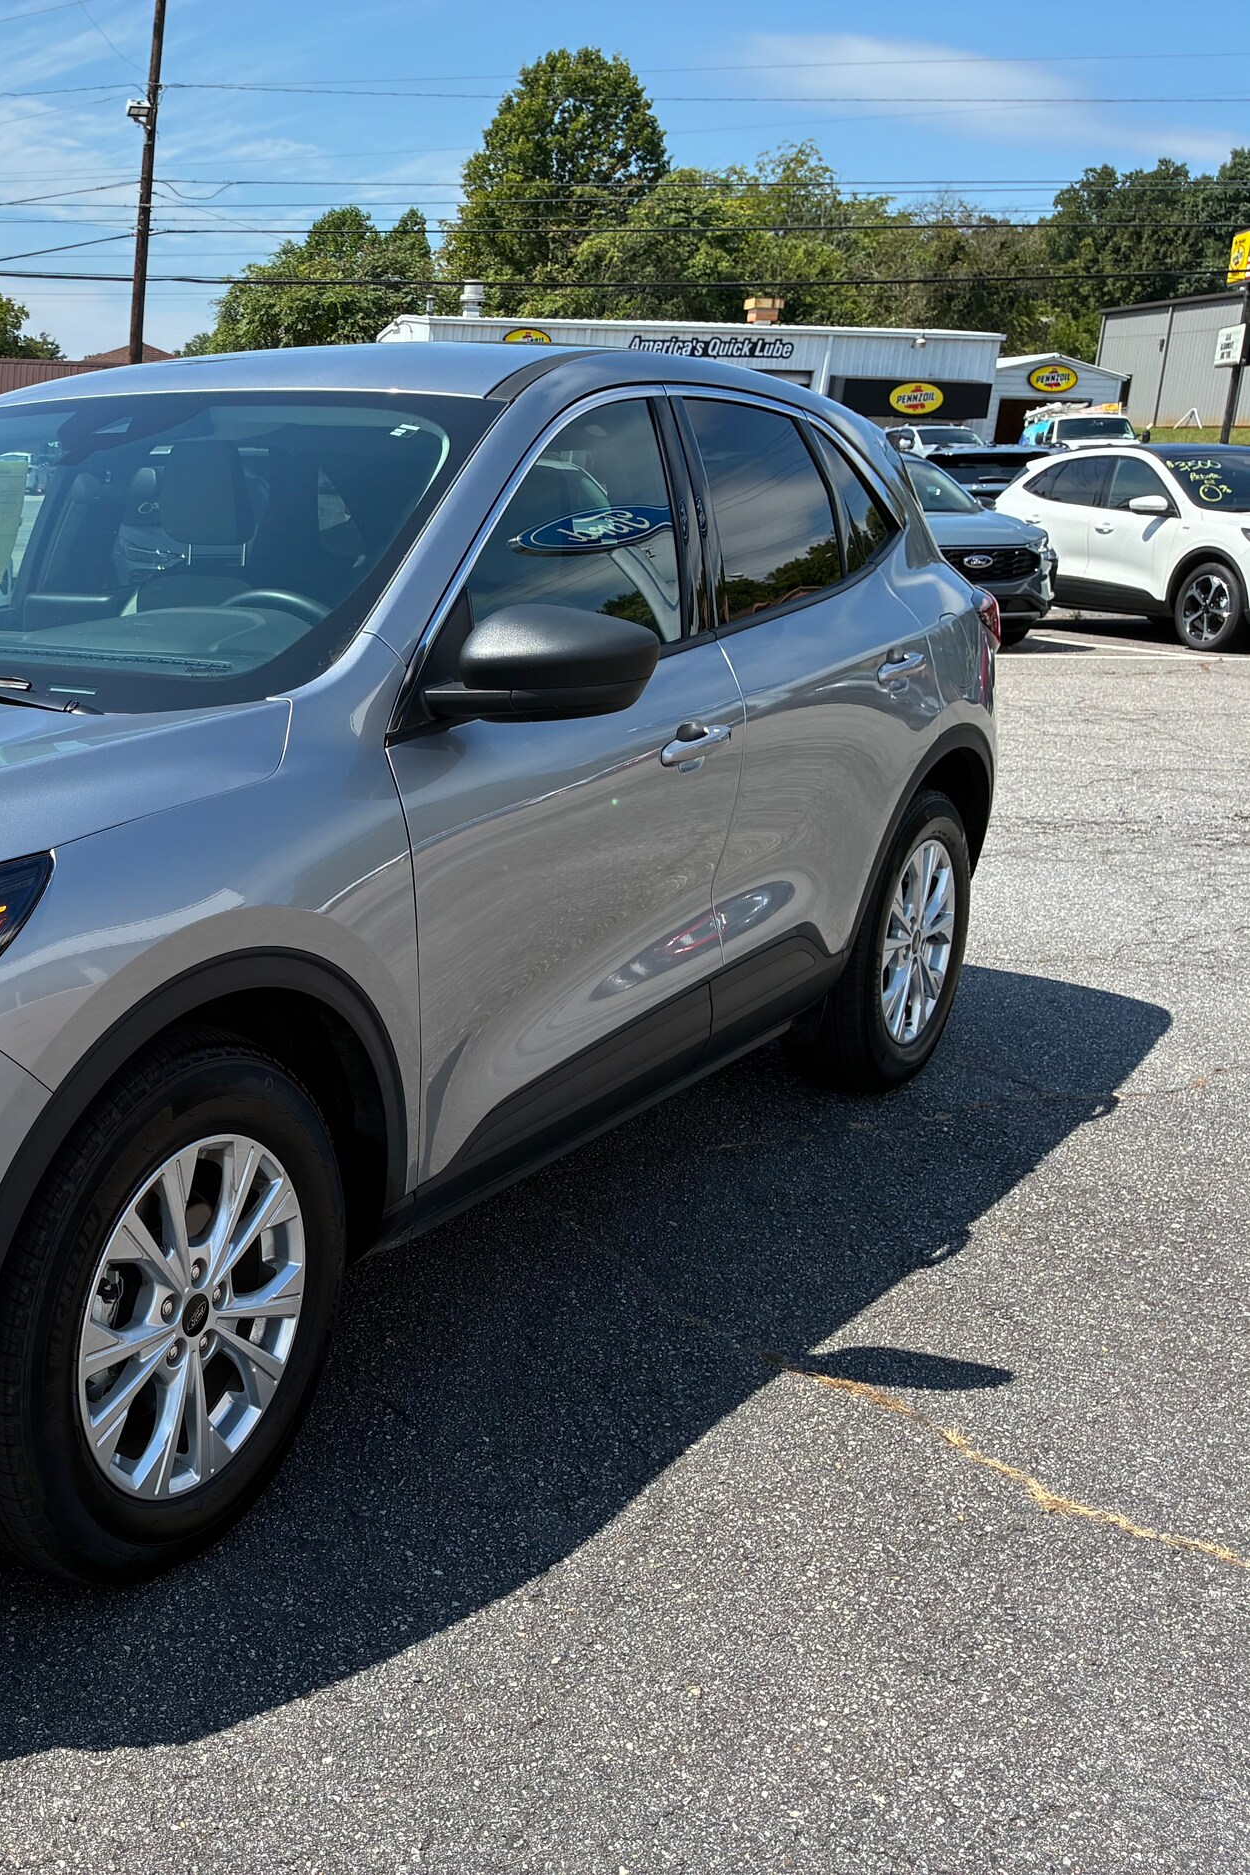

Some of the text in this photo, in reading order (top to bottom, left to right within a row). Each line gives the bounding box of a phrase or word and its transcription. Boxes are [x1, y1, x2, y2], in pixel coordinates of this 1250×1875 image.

[630, 336, 794, 359] America's Quick Lube
[1035, 372, 1071, 384] PENNZOIL
[895, 391, 937, 405] PENNZOIL
[49, 1210, 98, 1369] MICHELIN
